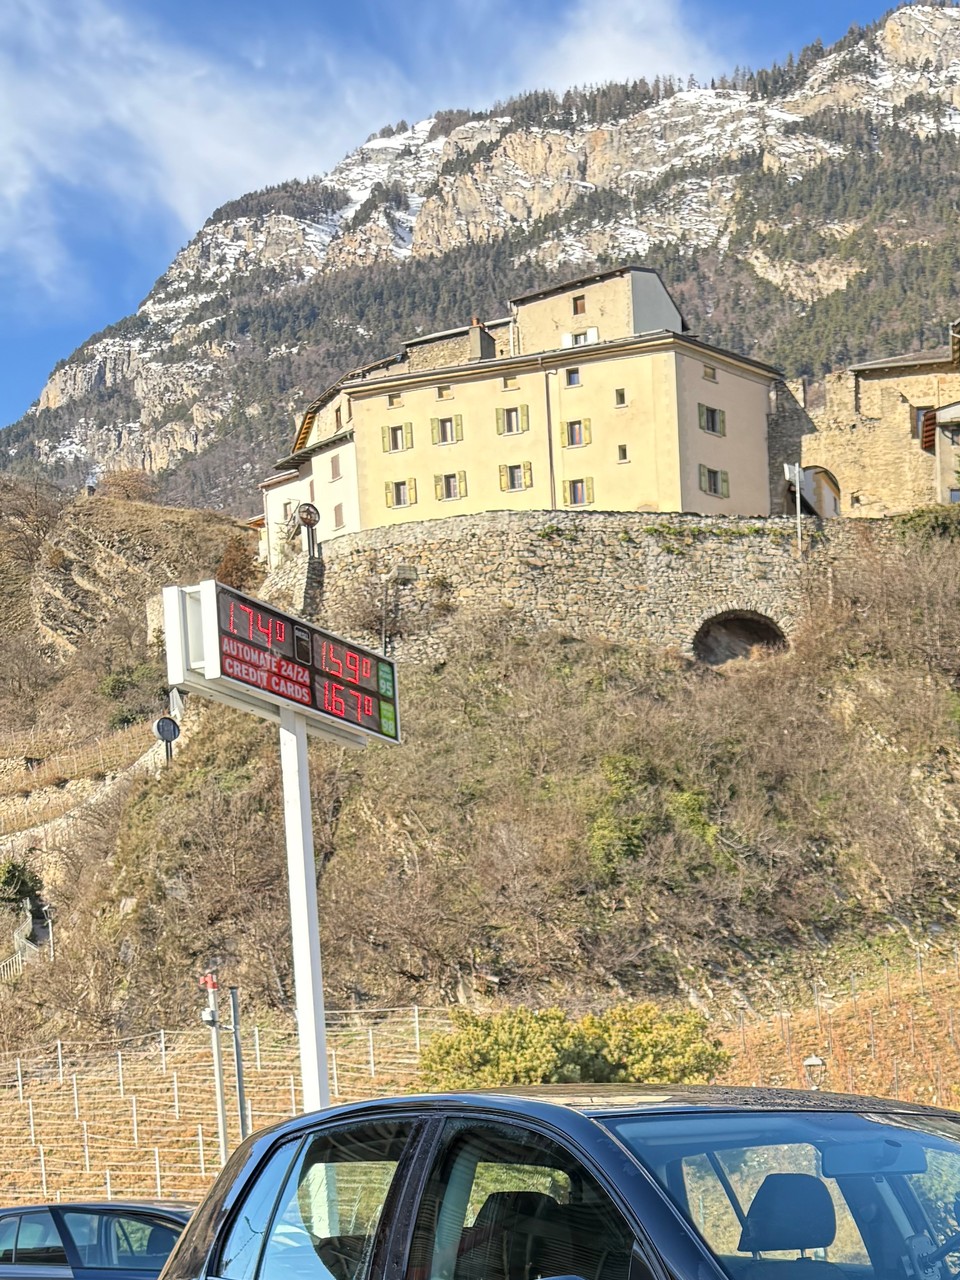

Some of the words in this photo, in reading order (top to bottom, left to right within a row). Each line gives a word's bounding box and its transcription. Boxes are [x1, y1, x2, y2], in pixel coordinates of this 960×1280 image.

[223, 638, 278, 672] AUTOMATE
[280, 661, 310, 683] 24/24
[225, 659, 268, 686] CREDIT
[271, 677, 309, 702] CARDS
[379, 679, 393, 696] 95
